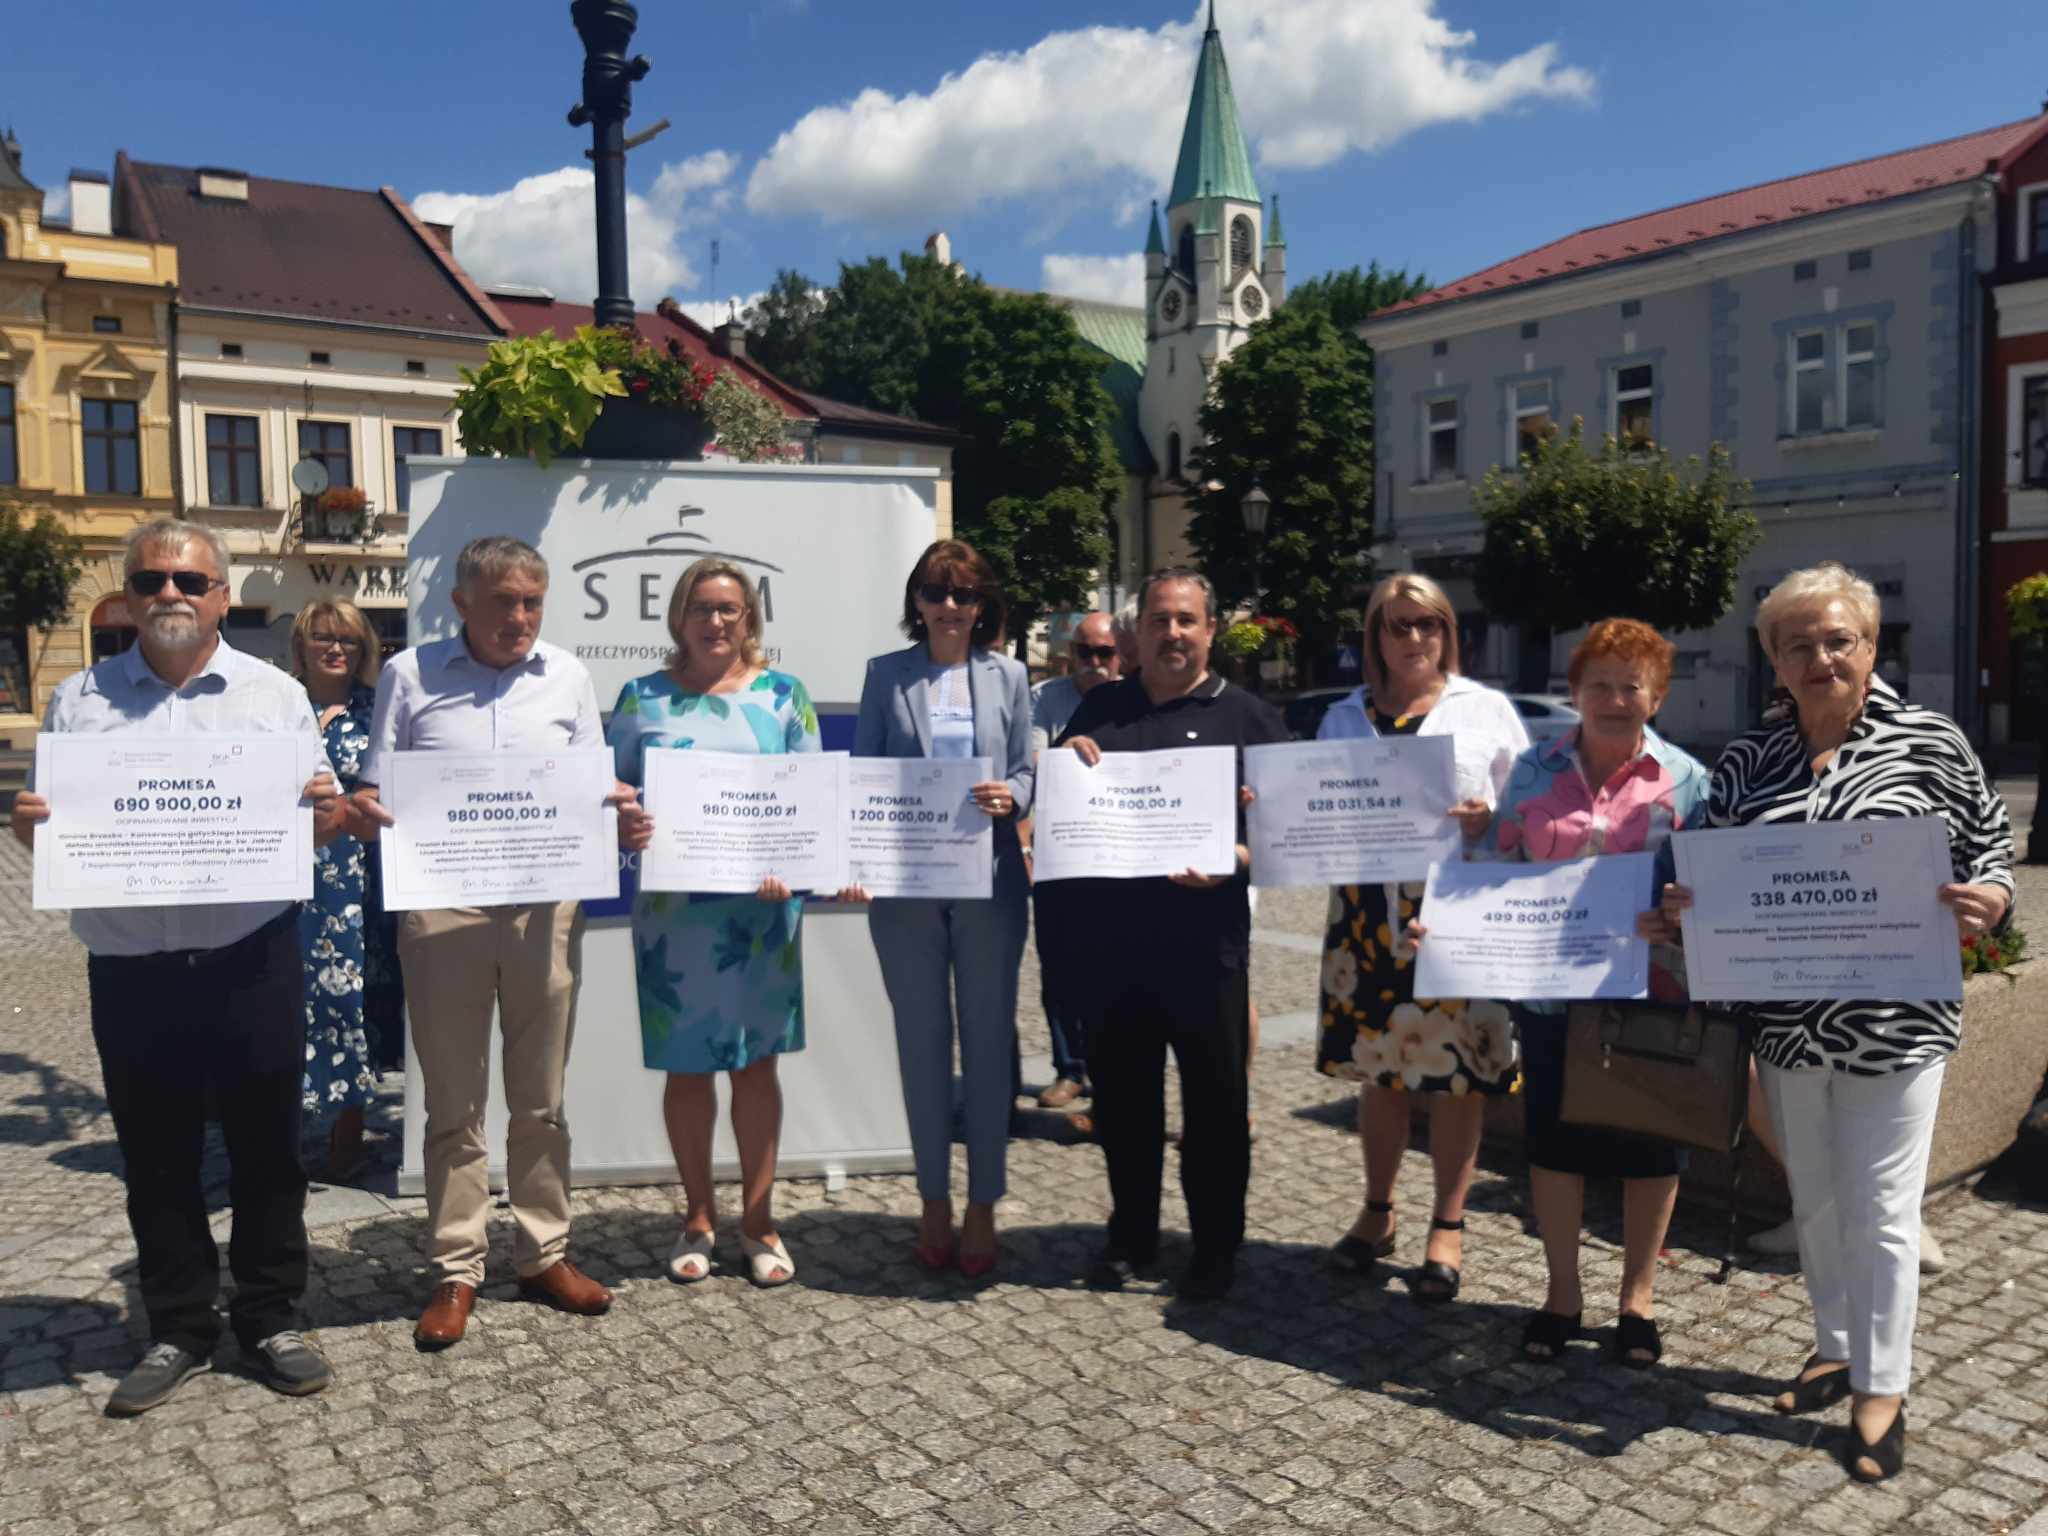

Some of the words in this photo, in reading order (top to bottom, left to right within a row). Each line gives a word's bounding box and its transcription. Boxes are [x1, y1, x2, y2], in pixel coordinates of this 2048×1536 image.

[584, 573, 774, 622] SEM
[138, 779, 216, 790] PROMESA
[1319, 778, 1379, 789] PROMESA
[1106, 786, 1161, 794] PROMESA
[468, 791, 533, 802] PROMESA
[721, 791, 776, 801] PROMESA
[869, 796, 922, 806] PROMESA
[114, 798, 149, 812] 690
[156, 796, 221, 812] 900,00
[228, 796, 241, 810] zł
[1089, 798, 1114, 807] 499
[448, 809, 479, 822] 980
[483, 807, 540, 821] 000,00
[545, 806, 556, 818] zł
[703, 805, 728, 815] 980
[733, 805, 781, 818] 000,00
[786, 806, 796, 816] zł
[859, 811, 884, 821] 200
[888, 811, 934, 824] 000,00
[938, 811, 948, 822] zł
[1772, 871, 1850, 884] PROMESA
[1505, 897, 1566, 907] PROMESA
[1751, 891, 1785, 906] 338
[1791, 889, 1856, 906] 470,00
[1862, 887, 1877, 902] zł
[1483, 912, 1512, 922] 499
